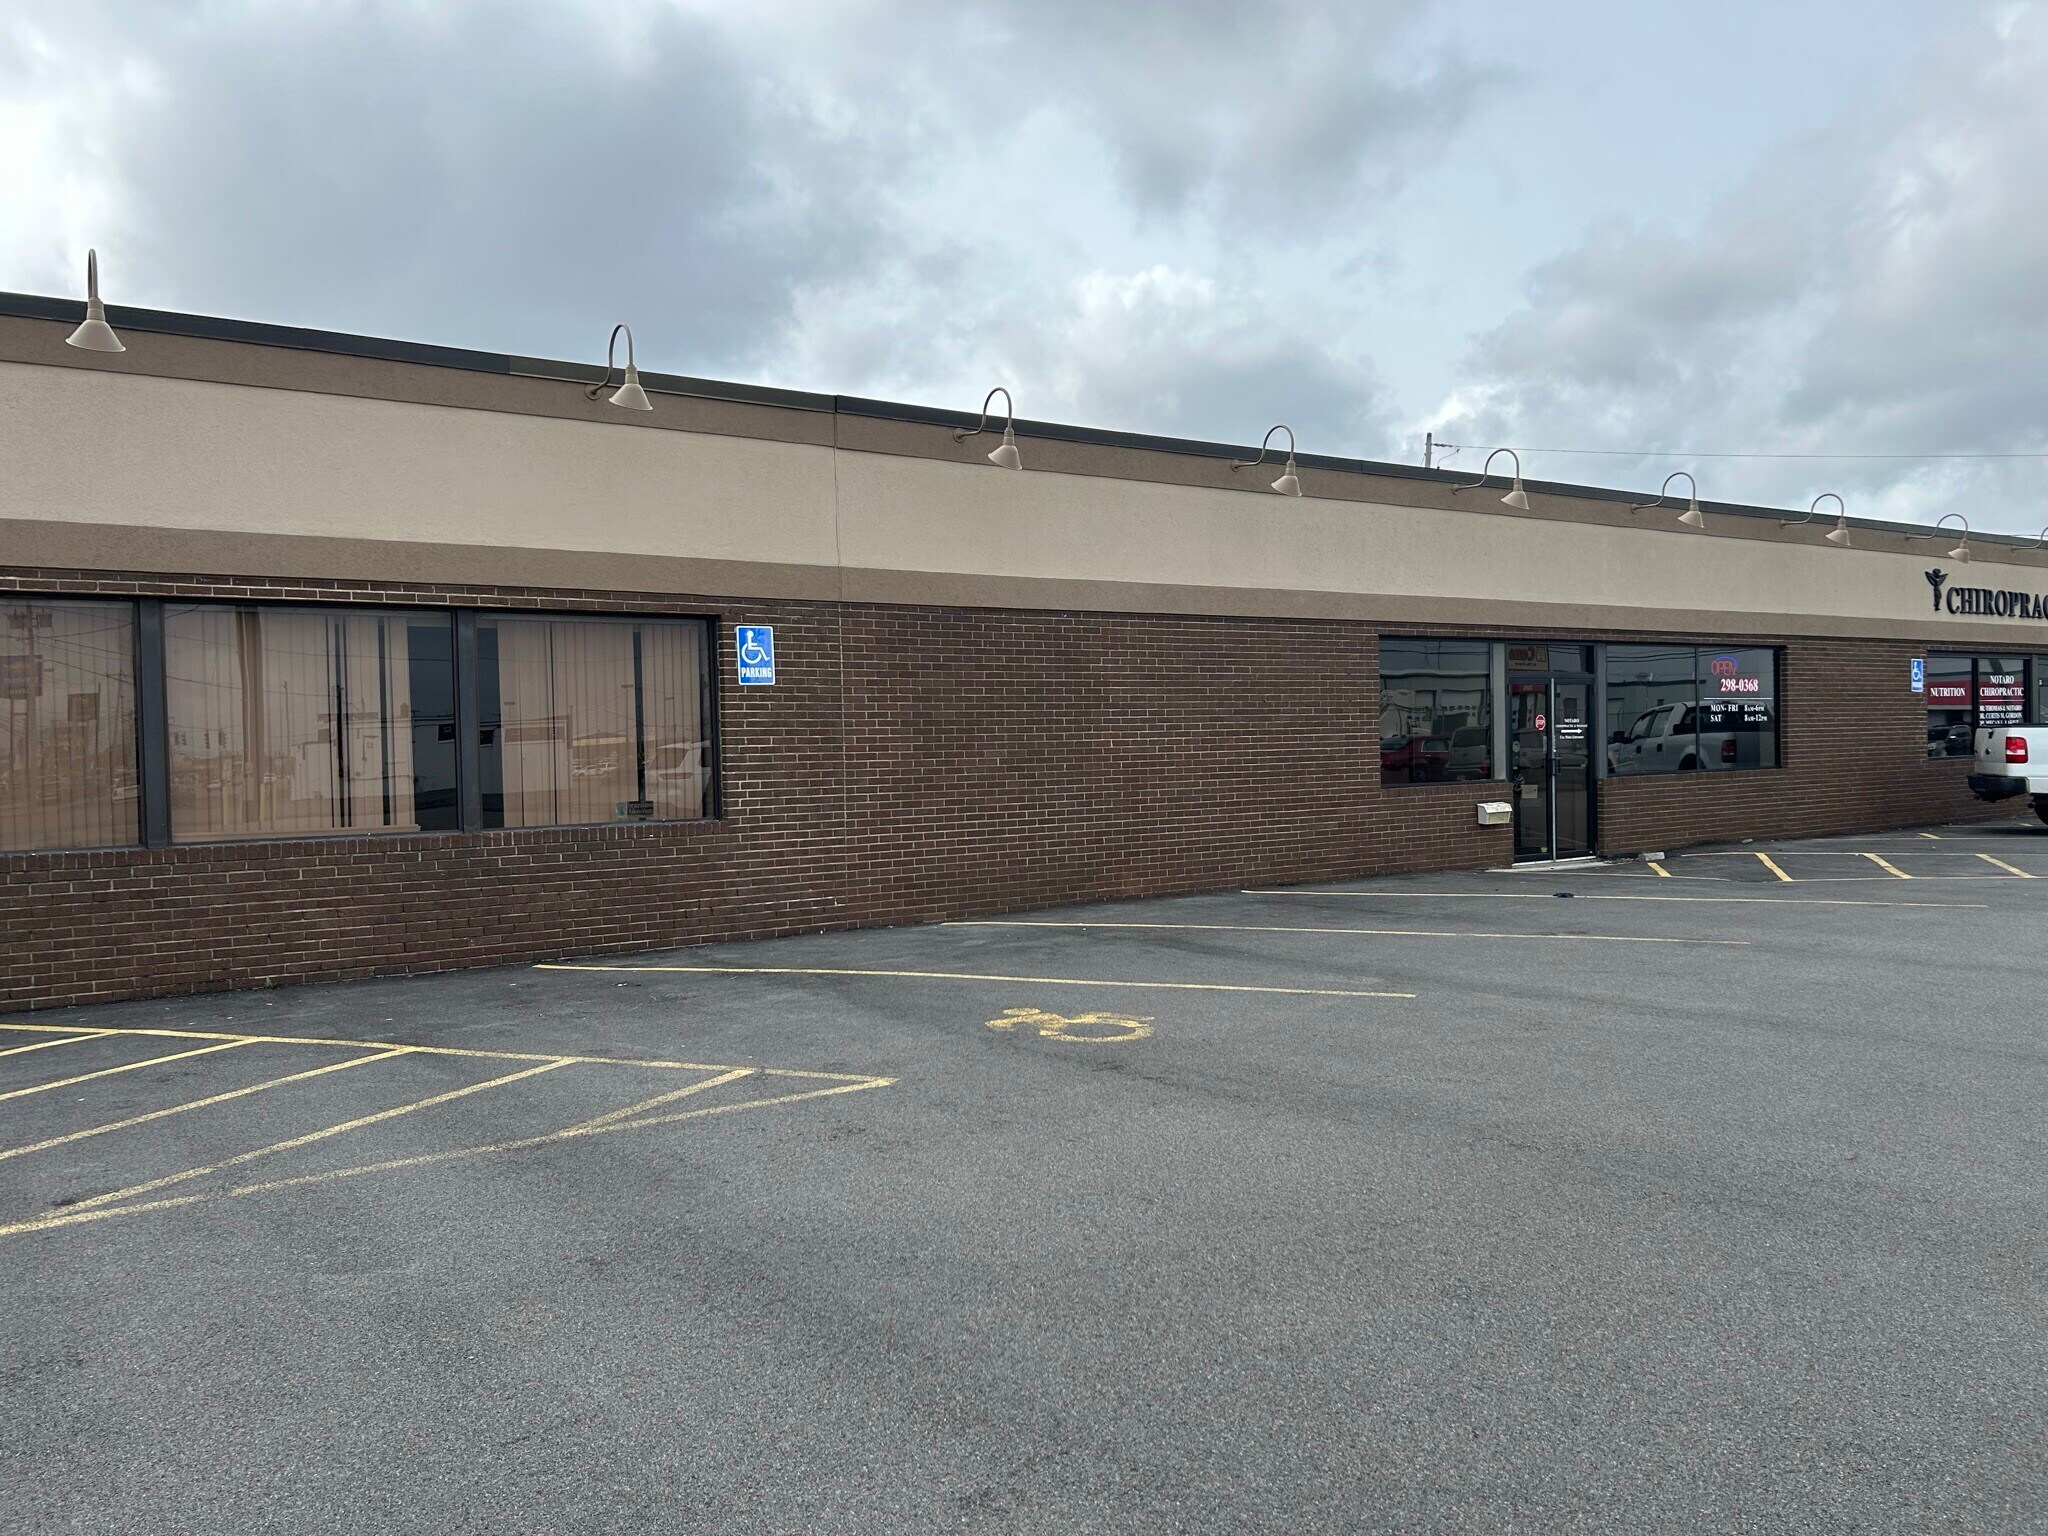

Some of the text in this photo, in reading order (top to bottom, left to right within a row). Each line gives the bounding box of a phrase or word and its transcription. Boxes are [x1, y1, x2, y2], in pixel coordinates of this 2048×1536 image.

[741, 667, 772, 678] PARKING
[1710, 660, 1736, 676] OPEN
[1720, 678, 1759, 692] 298-0368
[1990, 675, 2015, 685] NOTARO
[1930, 687, 1966, 697] NUTRITION
[1979, 687, 2025, 697] CHIROPRACTIC
[1728, 704, 1738, 712] FRI
[1710, 714, 1722, 722] SAT
